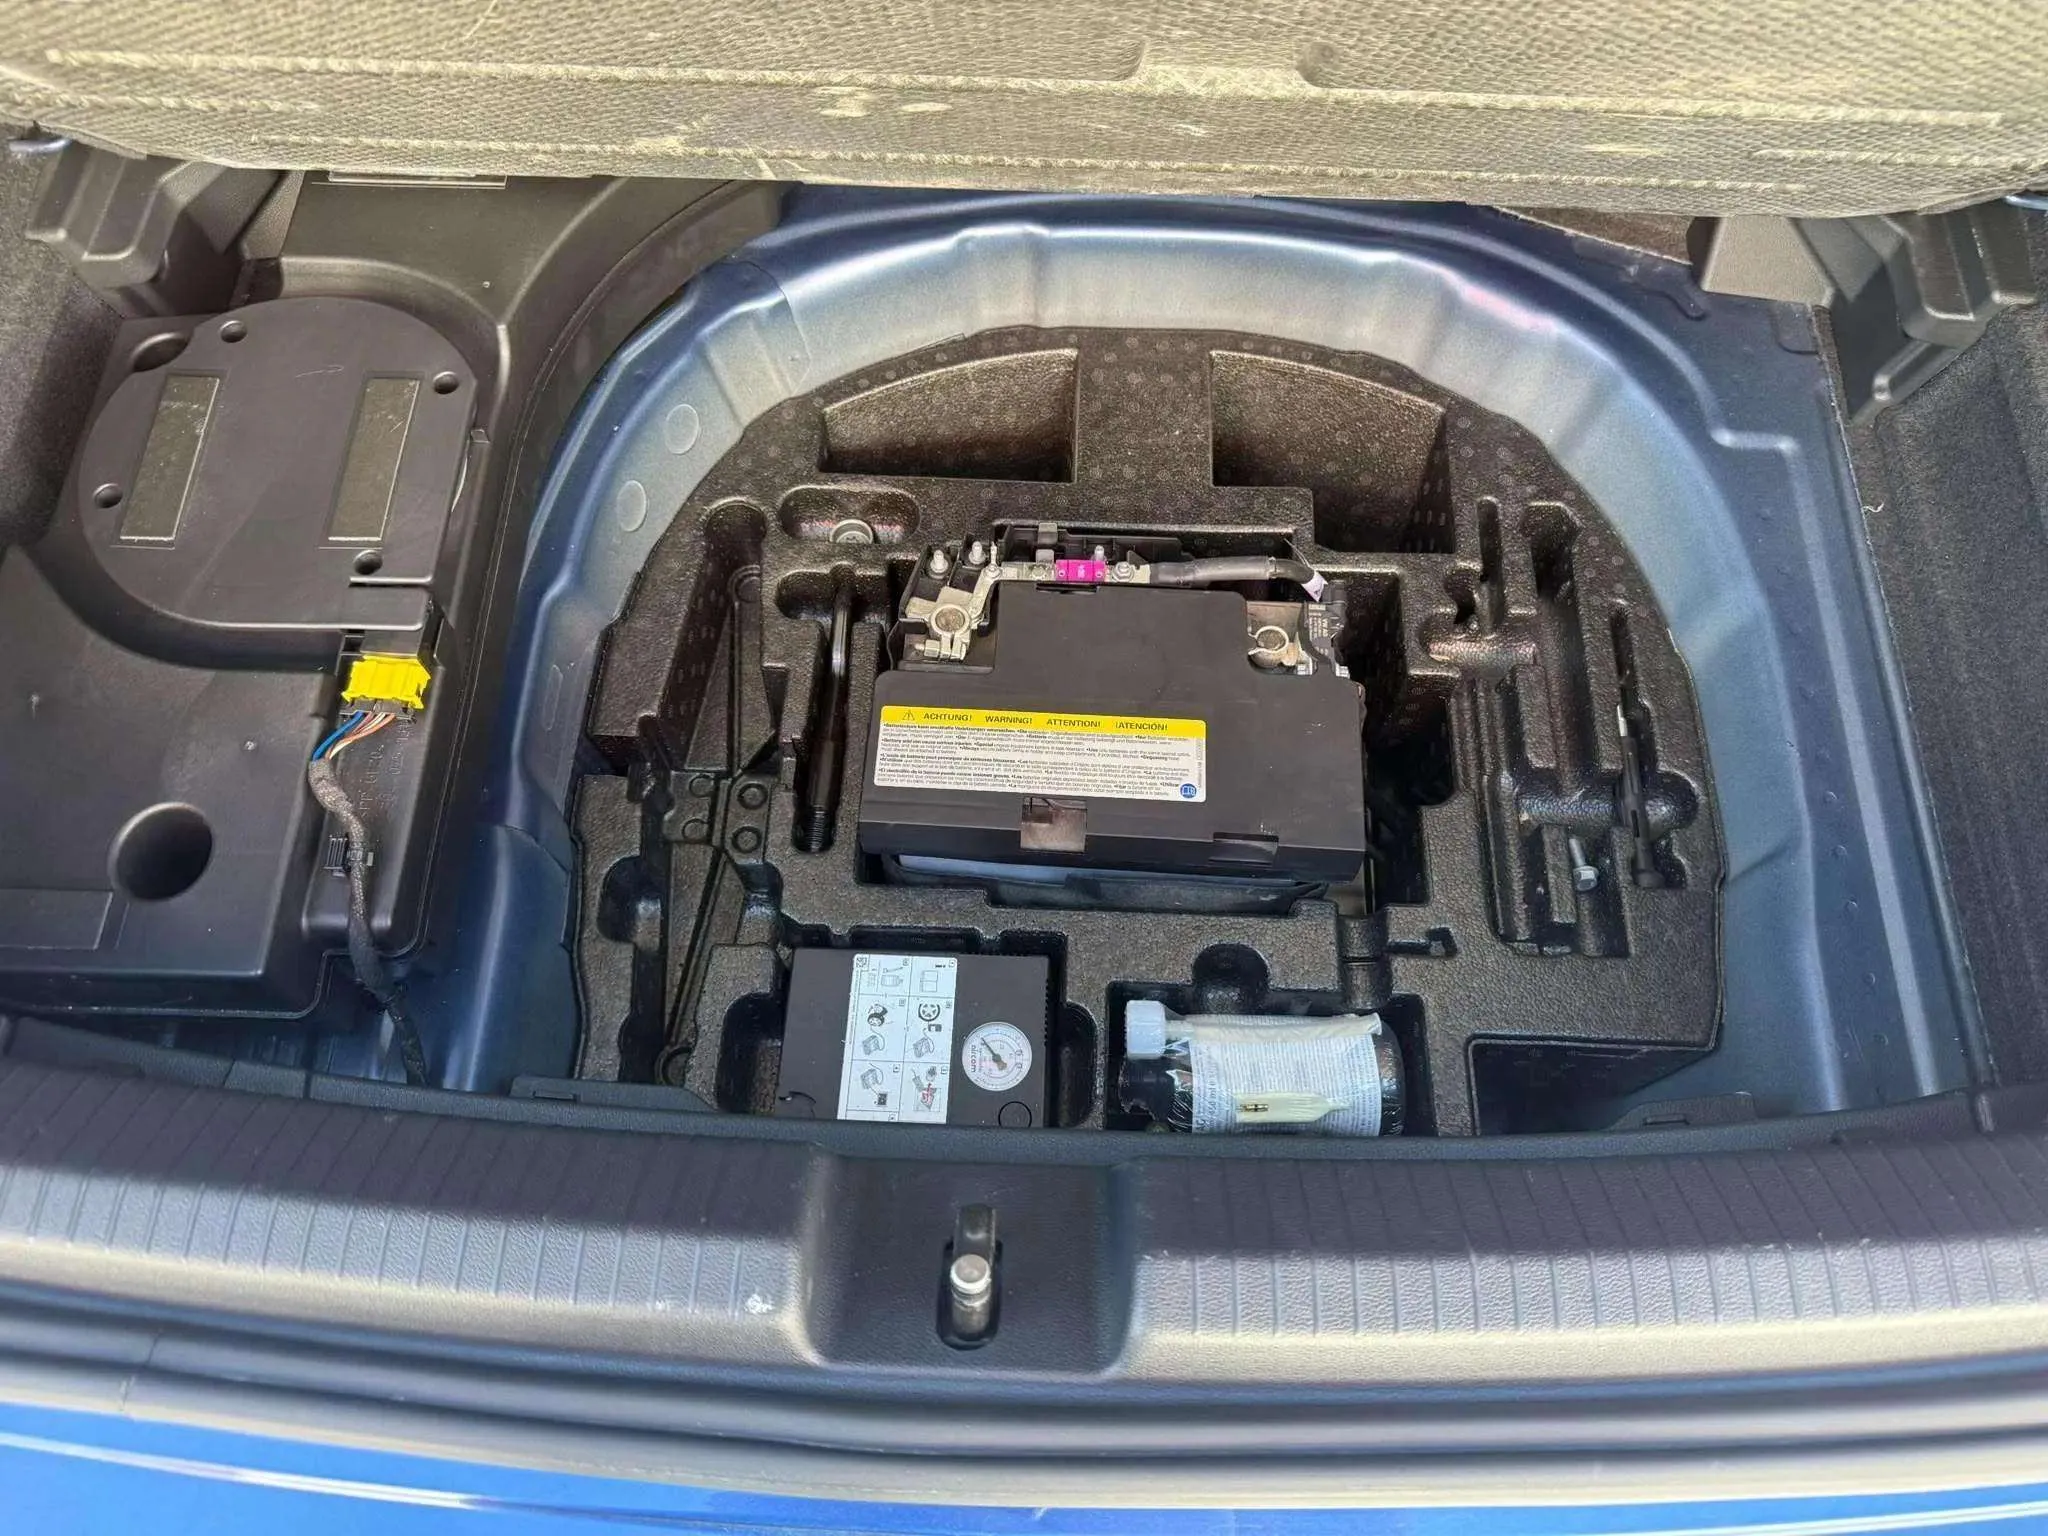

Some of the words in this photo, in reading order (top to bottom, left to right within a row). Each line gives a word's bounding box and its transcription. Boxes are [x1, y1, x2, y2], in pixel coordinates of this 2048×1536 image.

[923, 712, 972, 721] ACHTUNG!
[985, 715, 1032, 724] WARNING!
[1046, 718, 1101, 728] ATTENTION!
